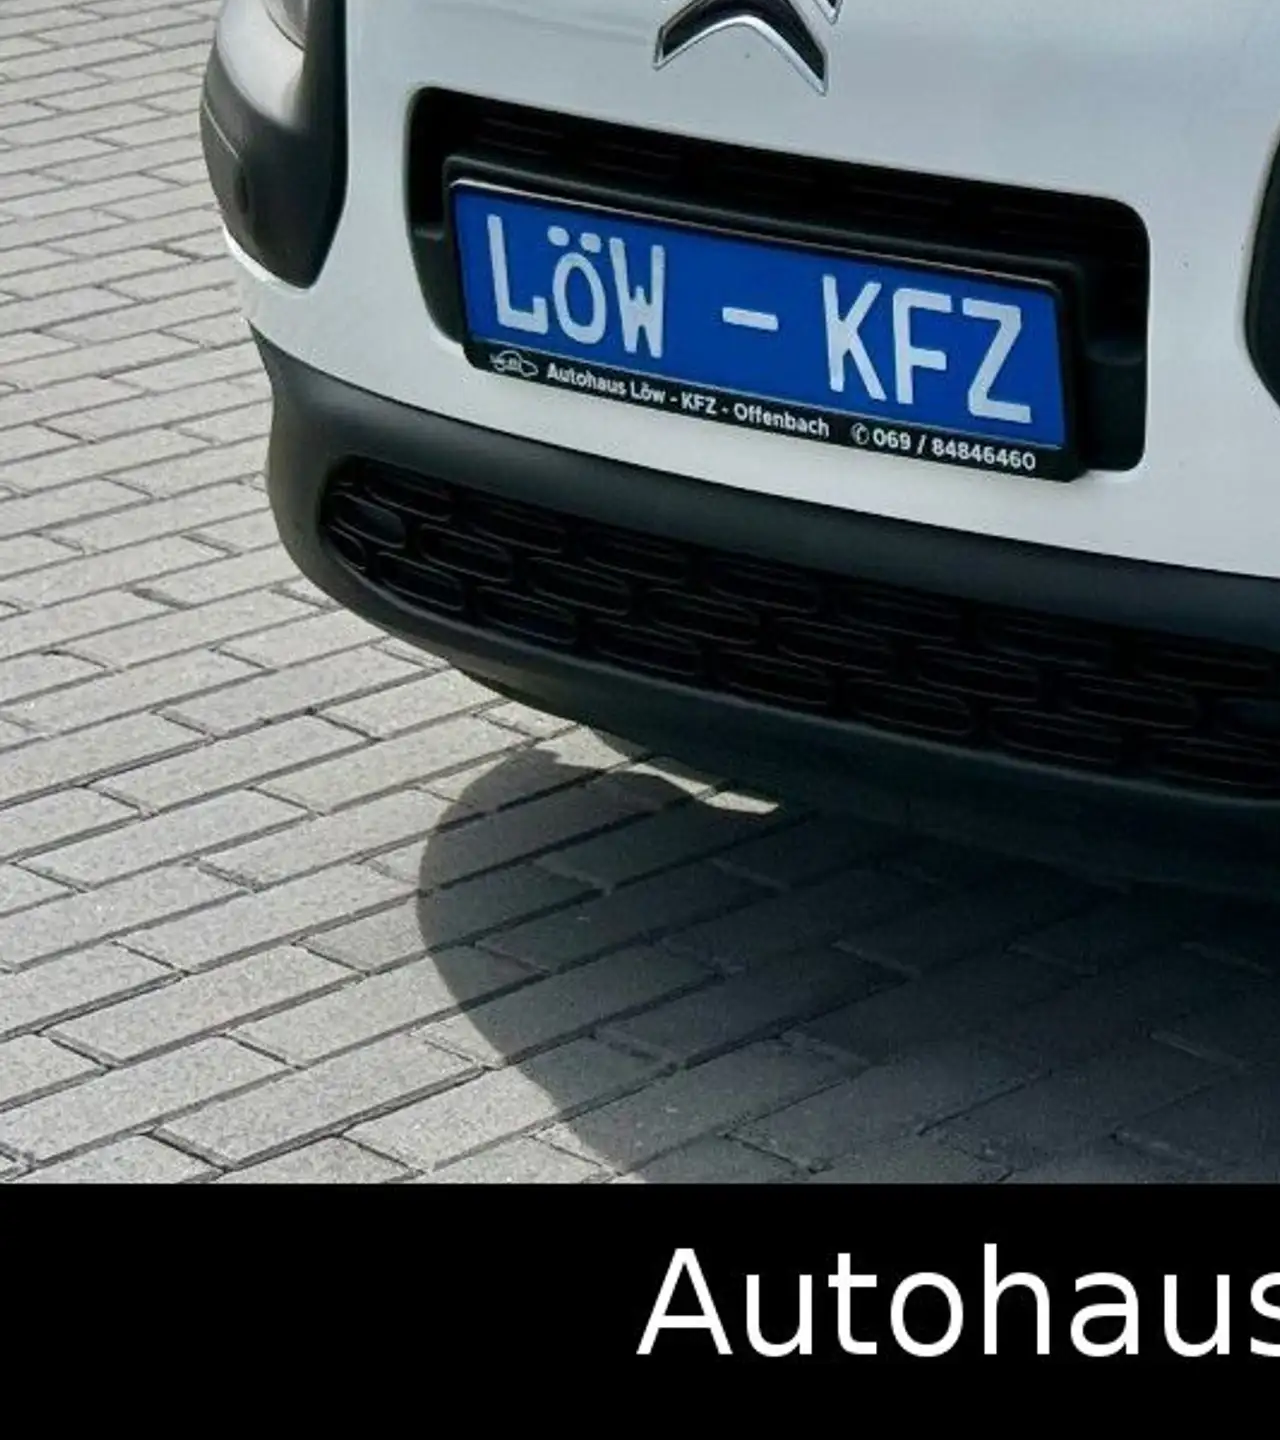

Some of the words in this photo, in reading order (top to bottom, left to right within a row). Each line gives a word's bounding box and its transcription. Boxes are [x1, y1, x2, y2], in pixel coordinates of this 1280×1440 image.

[722, 306, 780, 332] -
[822, 274, 1031, 424] KFZ
[547, 363, 627, 396] Autohaus
[629, 381, 667, 404] Löw
[681, 391, 718, 415] KFZ
[733, 402, 830, 438] Offenbach
[872, 427, 912, 450] 069
[931, 437, 1037, 471] 84846460
